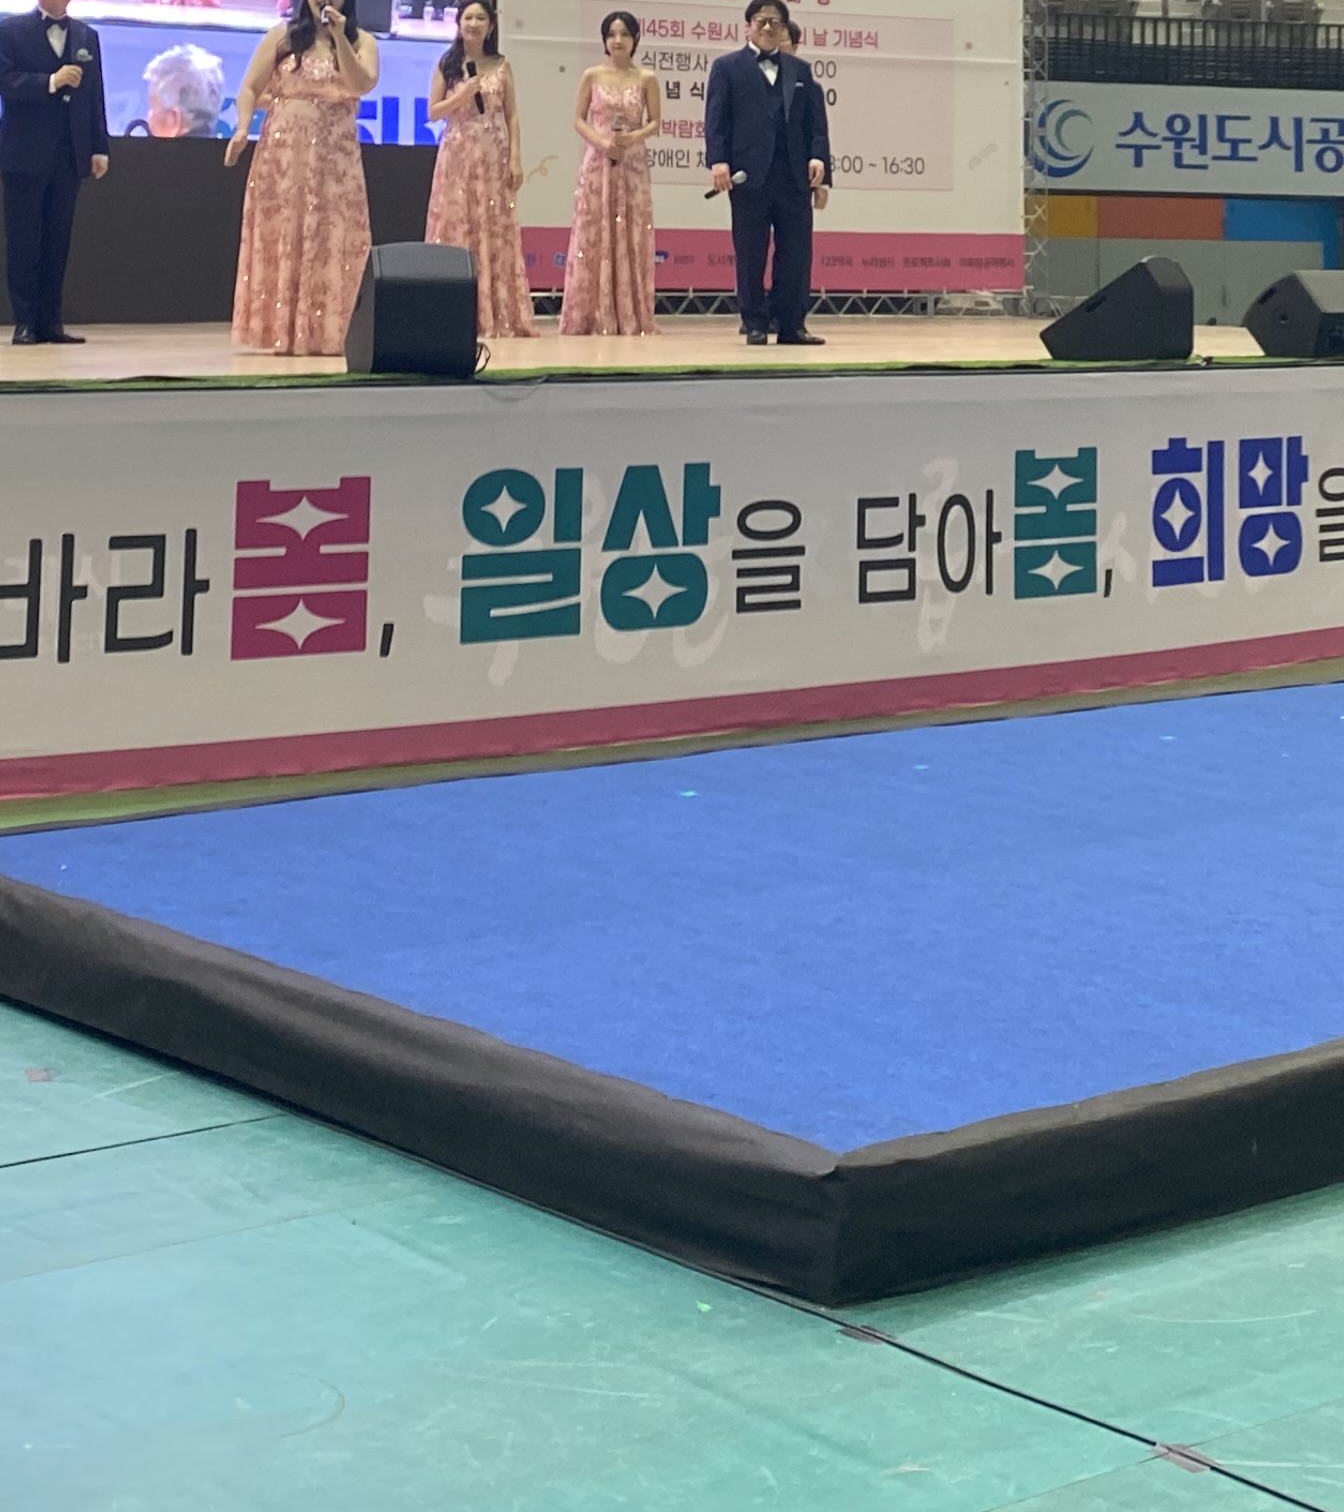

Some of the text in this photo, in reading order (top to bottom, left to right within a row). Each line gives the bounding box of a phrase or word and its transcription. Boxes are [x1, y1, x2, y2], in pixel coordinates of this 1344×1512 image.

[690, 20, 739, 42] 수원시
[832, 29, 879, 49] 기념식
[640, 50, 708, 72] 식전행사
[881, 155, 926, 176] 16:30
[459, 461, 806, 645] 일상을
[856, 445, 1113, 606] 담아봄,
